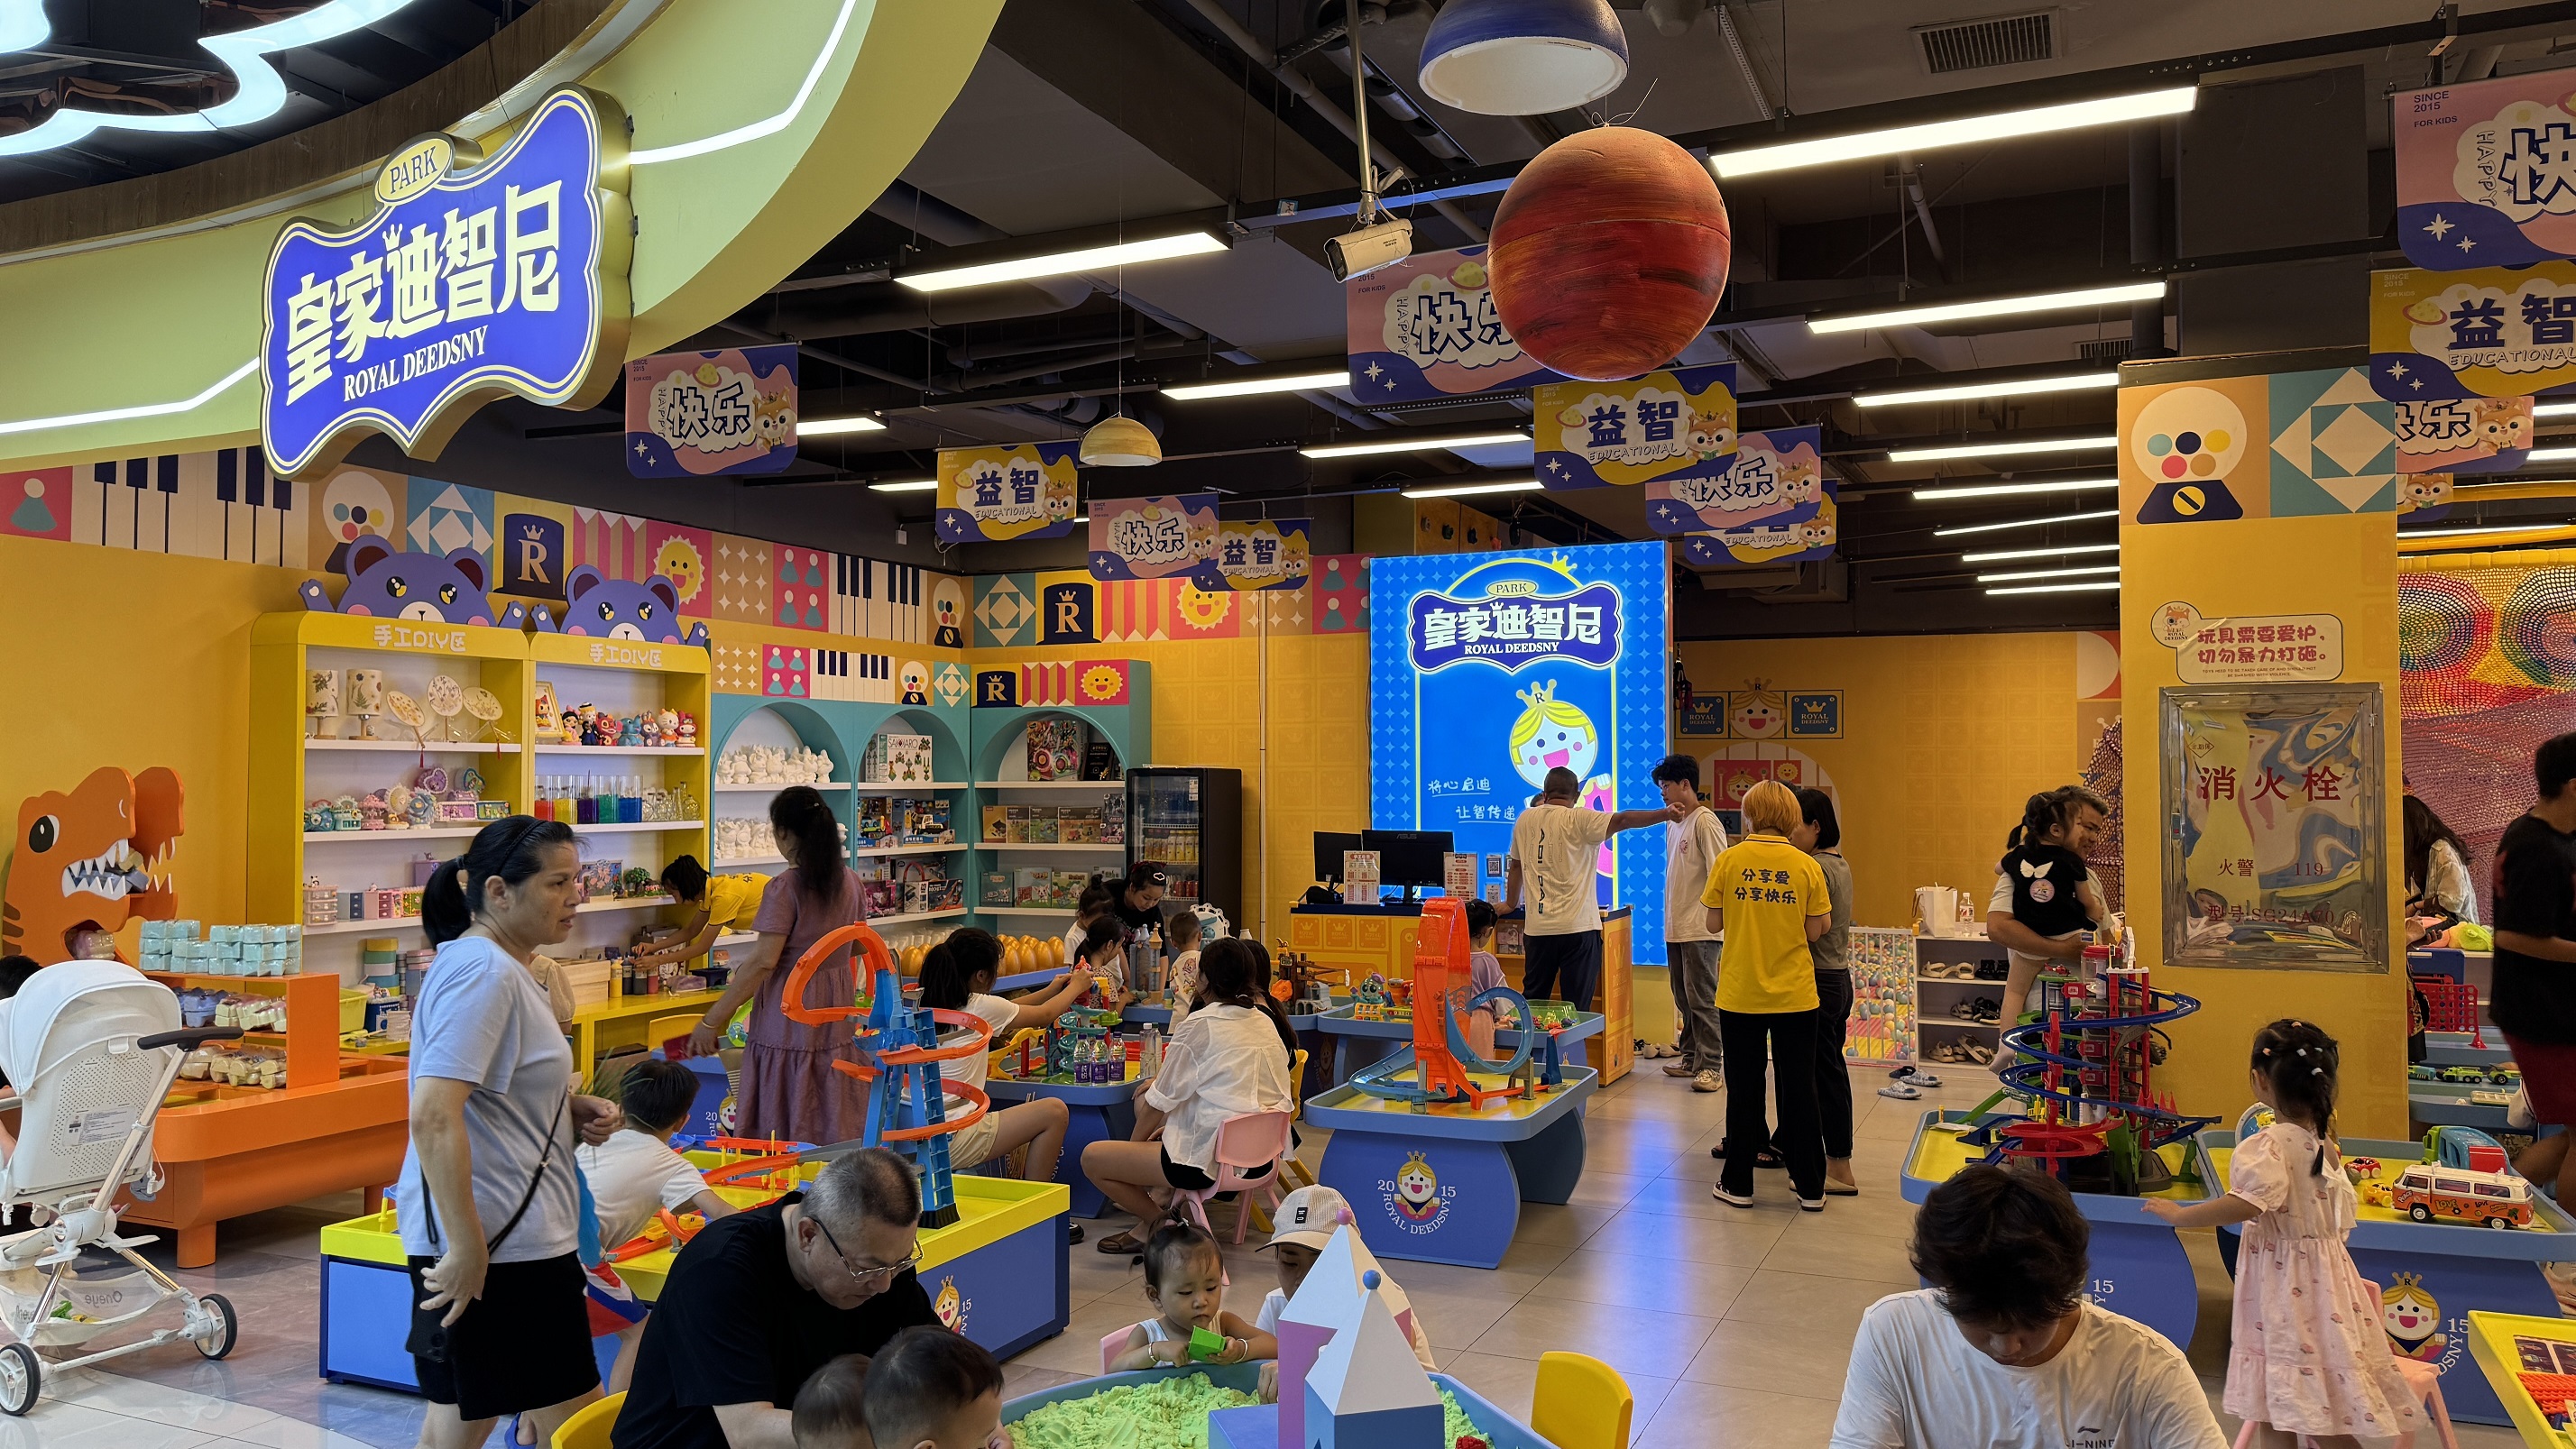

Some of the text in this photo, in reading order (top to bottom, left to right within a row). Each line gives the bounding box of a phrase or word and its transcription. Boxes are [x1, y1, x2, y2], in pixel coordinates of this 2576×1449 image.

[2414, 91, 2450, 103] SINCE
[2414, 102, 2441, 113] 2015
[2414, 115, 2458, 127] FOR KIDS
[390, 146, 438, 194] PARK
[2477, 131, 2498, 206] HAPPY
[2498, 123, 2576, 206] 快
[1357, 273, 1375, 282] 2015
[287, 180, 562, 406] 皇家迪智尼
[1371, 284, 1385, 292] KIDS
[1396, 297, 1410, 355] HAPPY
[2448, 293, 2576, 351] 益智
[344, 326, 489, 402] ROYAL DEEDSNY
[2449, 347, 2576, 365] EDUCATIONAL
[658, 387, 667, 437] HAPPY
[667, 381, 751, 439] 快乐
[1587, 399, 1679, 448] 益智
[1587, 443, 1678, 461] EDUCATIONAL
[974, 467, 1039, 507] 益智
[1688, 456, 1774, 502] 快乐
[975, 506, 1036, 518] EDUCATIONAL
[1121, 518, 1185, 555] 快乐
[1725, 534, 1792, 544] EDUCATIONAL
[1223, 537, 1277, 565] 益智
[518, 538, 551, 583] R
[1496, 582, 1527, 592] PARK
[1054, 601, 1083, 633] R
[1424, 603, 1602, 651] 皇家迪智尼
[373, 625, 466, 652] 手工DIY区
[589, 644, 663, 668] 手工DIY区
[1464, 642, 1559, 654] ROYAL DEEDSNY
[2197, 645, 2326, 664] 切勿暴力打砸。
[986, 682, 1007, 702] R
[1534, 692, 1546, 704] R
[1428, 777, 1491, 793] 将心启迪
[2199, 766, 2342, 802] 消火栓
[1456, 805, 1516, 820] 让智传递
[1742, 868, 1789, 885] 分享爱
[2217, 858, 2255, 877] 火警
[2295, 862, 2323, 877] 119
[1734, 887, 1796, 903] 分享快乐
[705, 1112, 718, 1121] 20
[1377, 1179, 1395, 1192] 20
[1440, 1186, 1456, 1197] 15
[1383, 1193, 1450, 1234] ROYAL DEEDSNY
[2435, 1199, 2459, 1211] LOVE
[2093, 1279, 2114, 1294] 15
[961, 1298, 971, 1313] 15
[2448, 1317, 2469, 1334] 15
